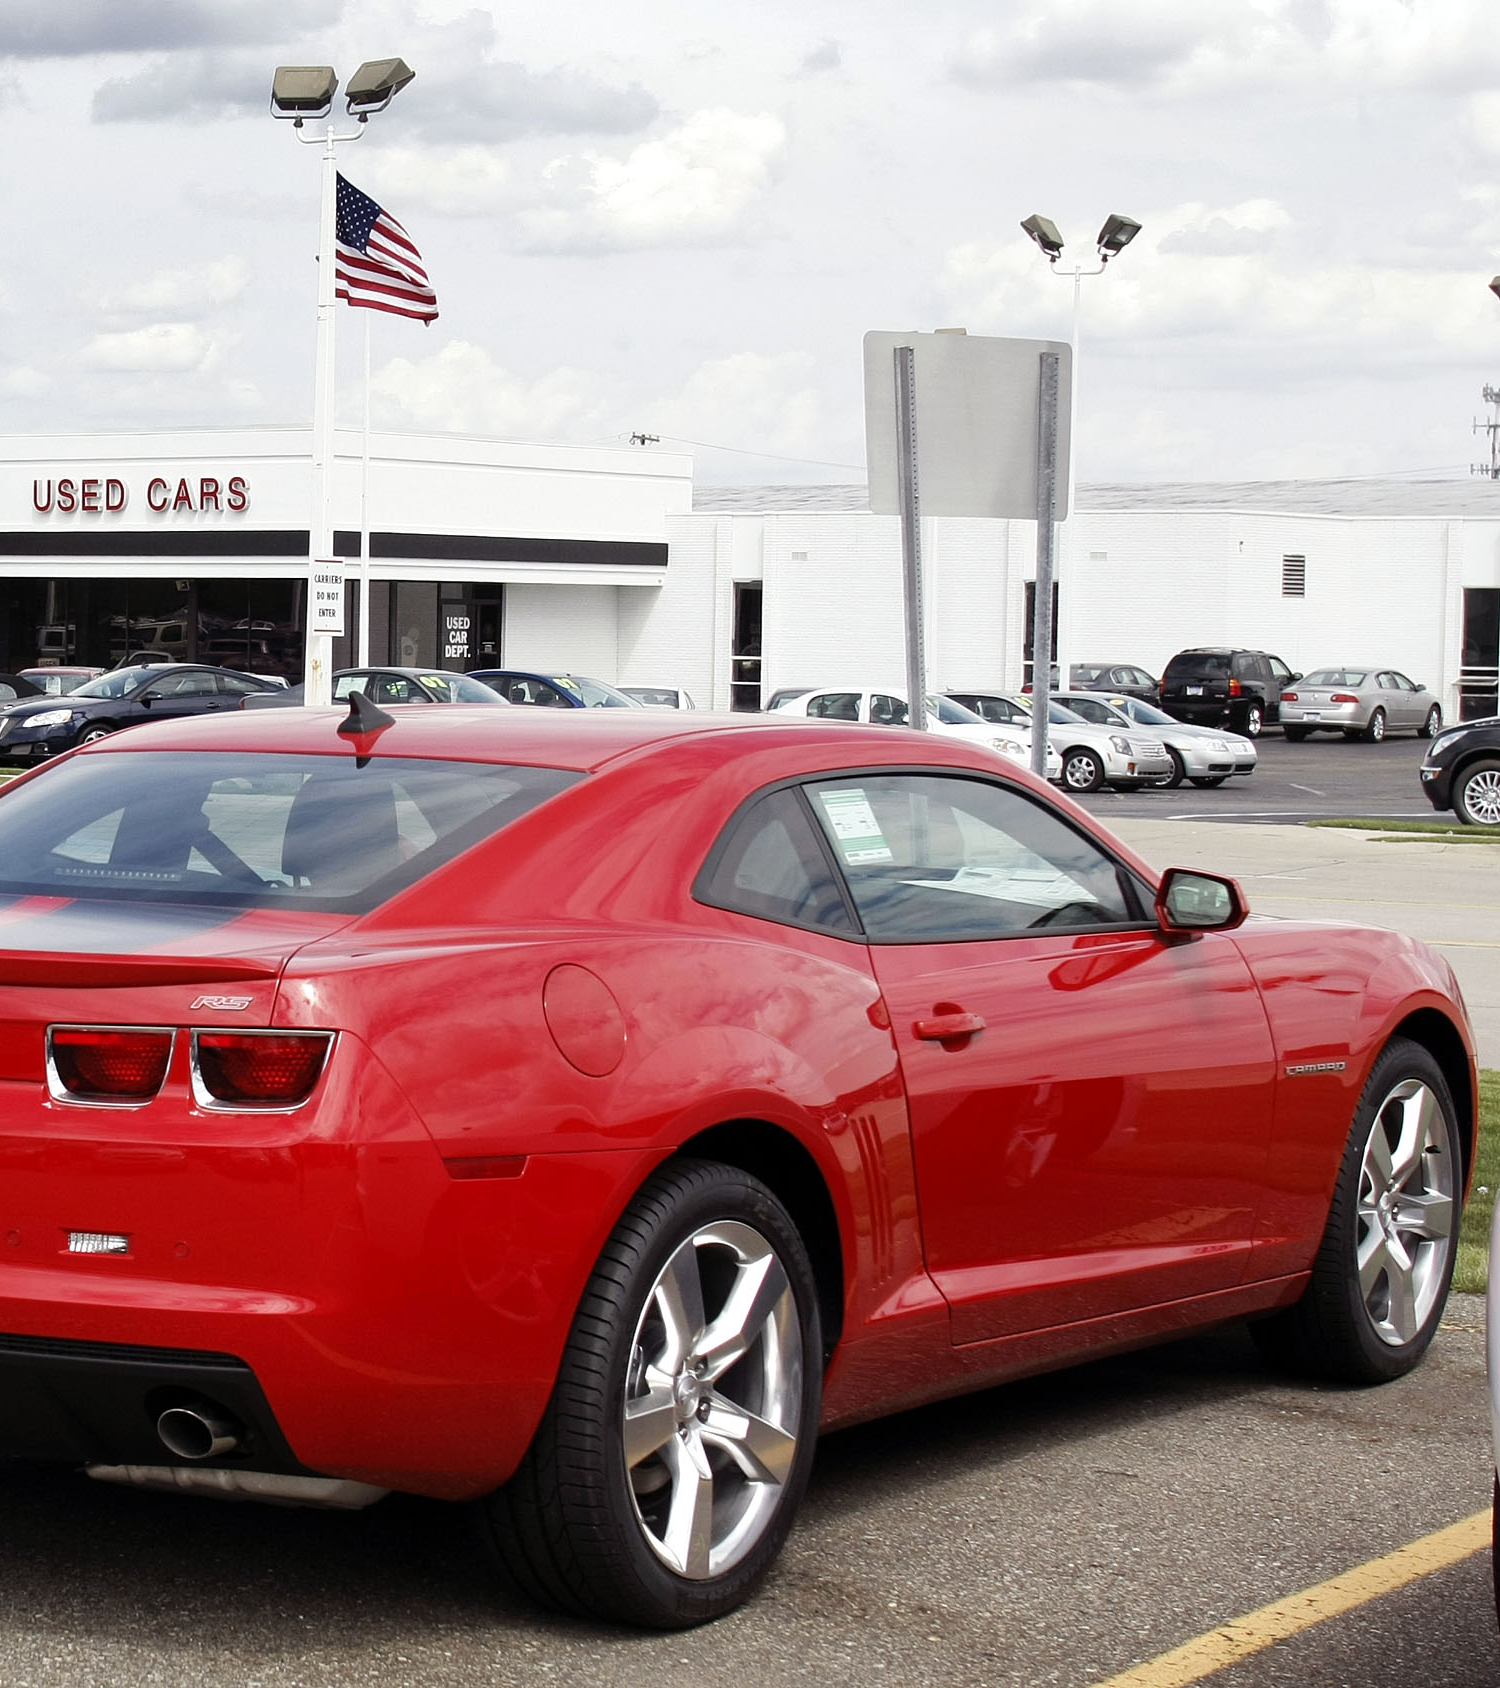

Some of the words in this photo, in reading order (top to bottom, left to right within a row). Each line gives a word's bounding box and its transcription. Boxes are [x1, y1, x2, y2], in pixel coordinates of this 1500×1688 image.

[33, 478, 126, 513] USED
[147, 477, 250, 512] CARS
[314, 574, 342, 584] CARRIERS
[316, 591, 324, 600] DO
[327, 592, 339, 601] NOT
[318, 608, 336, 617] ENTER
[446, 616, 470, 629] USED
[449, 631, 468, 644] CAR
[444, 644, 471, 658] DEPT.
[189, 995, 253, 1010] RS
